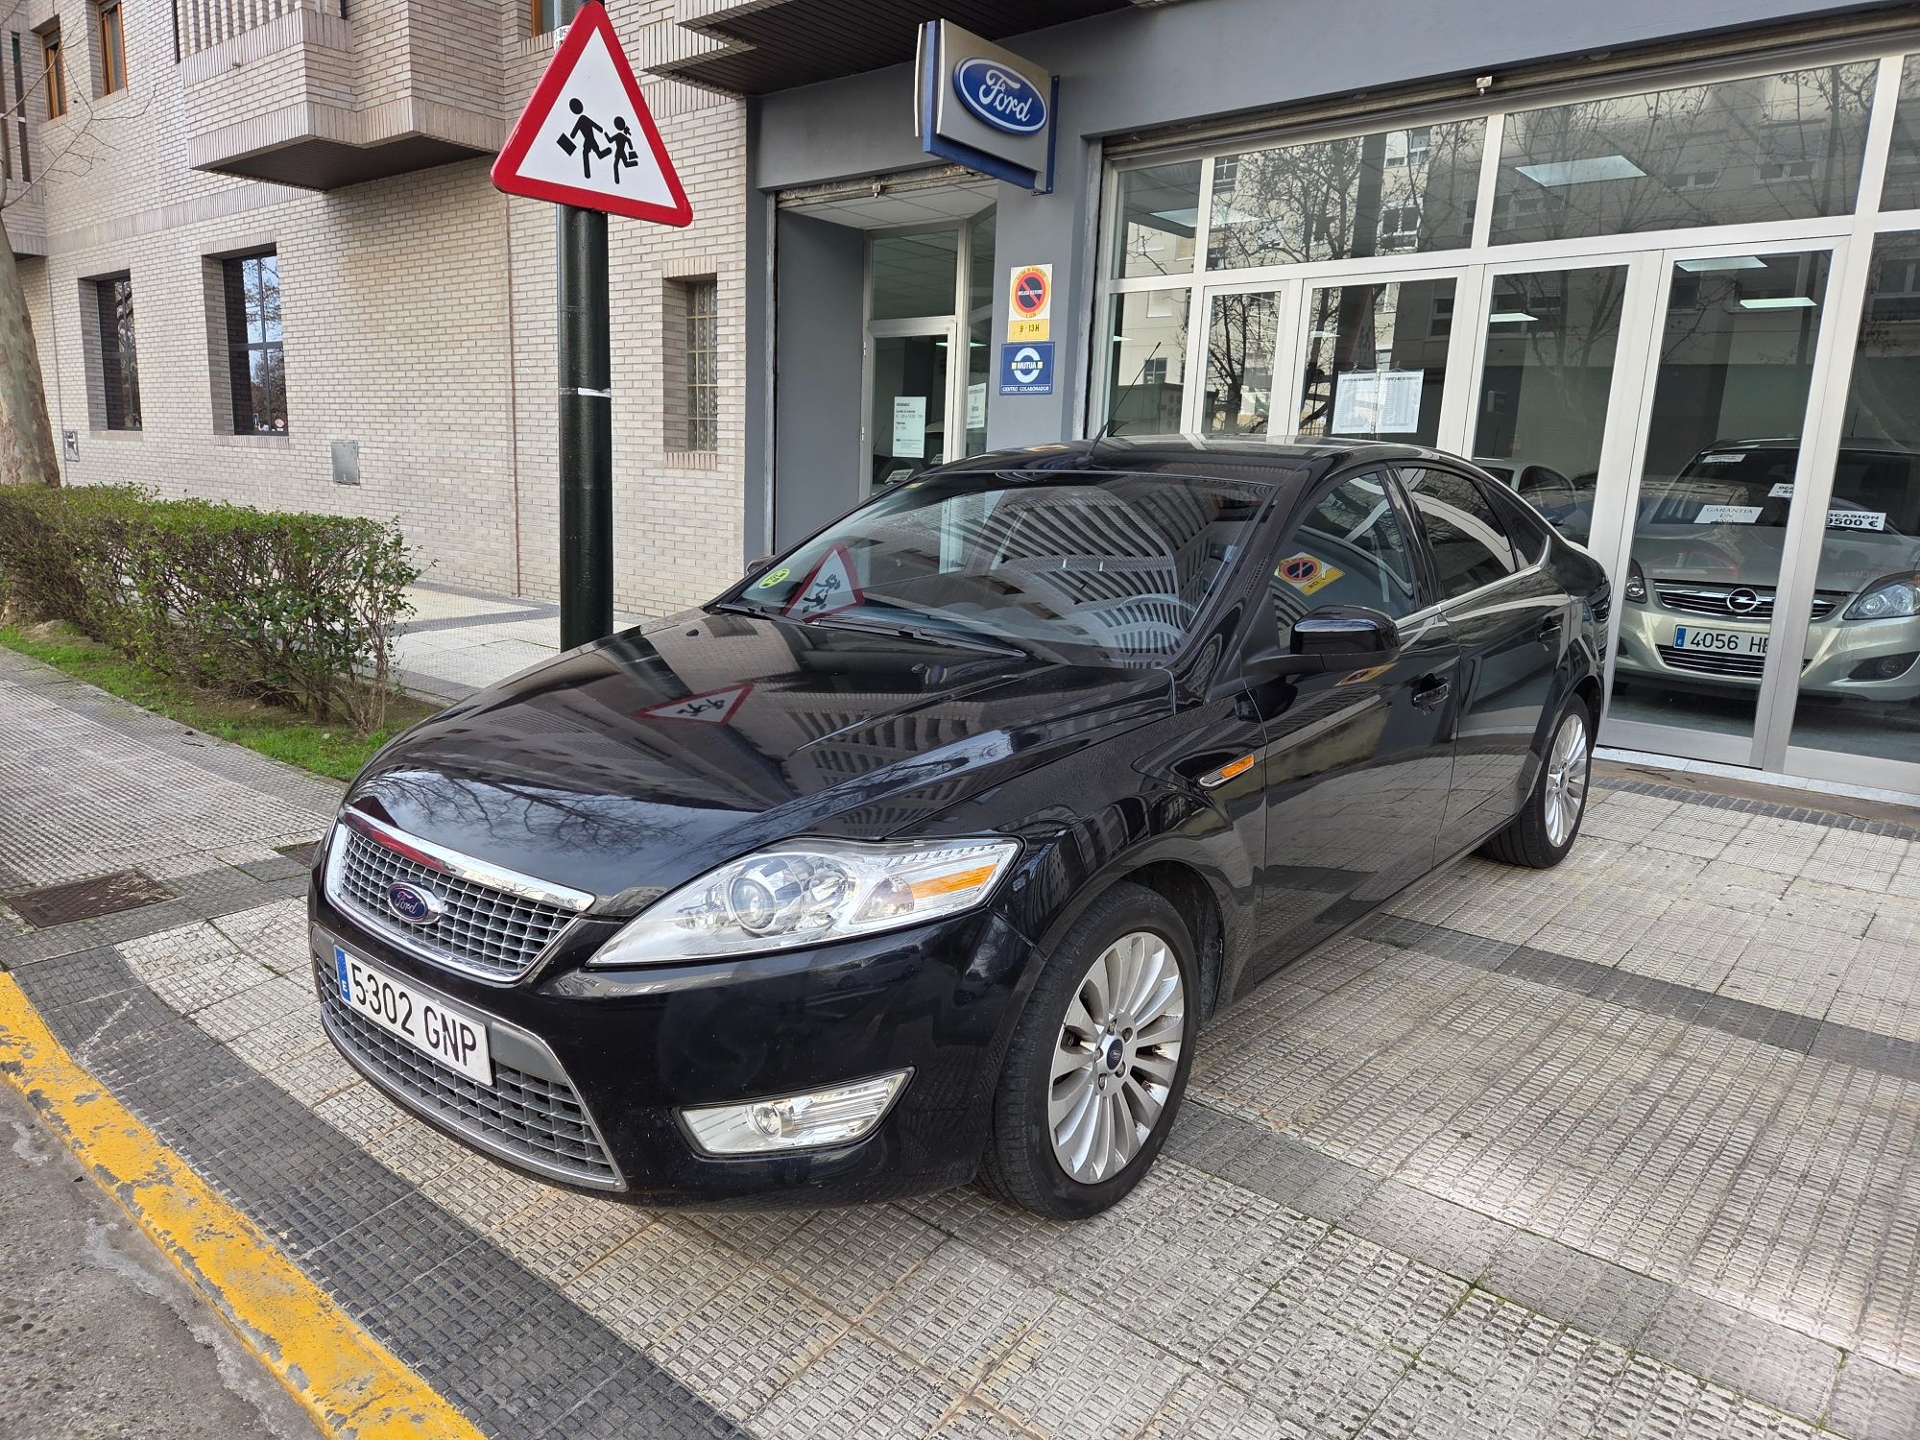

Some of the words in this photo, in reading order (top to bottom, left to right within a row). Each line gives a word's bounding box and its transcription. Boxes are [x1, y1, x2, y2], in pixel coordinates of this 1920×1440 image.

[978, 69, 1034, 122] Ford
[1017, 361, 1037, 370] MUTUA
[1690, 631, 1739, 651] 4056
[394, 891, 417, 915] Ford
[351, 962, 415, 1037] 5302
[424, 1005, 477, 1067] GNP
